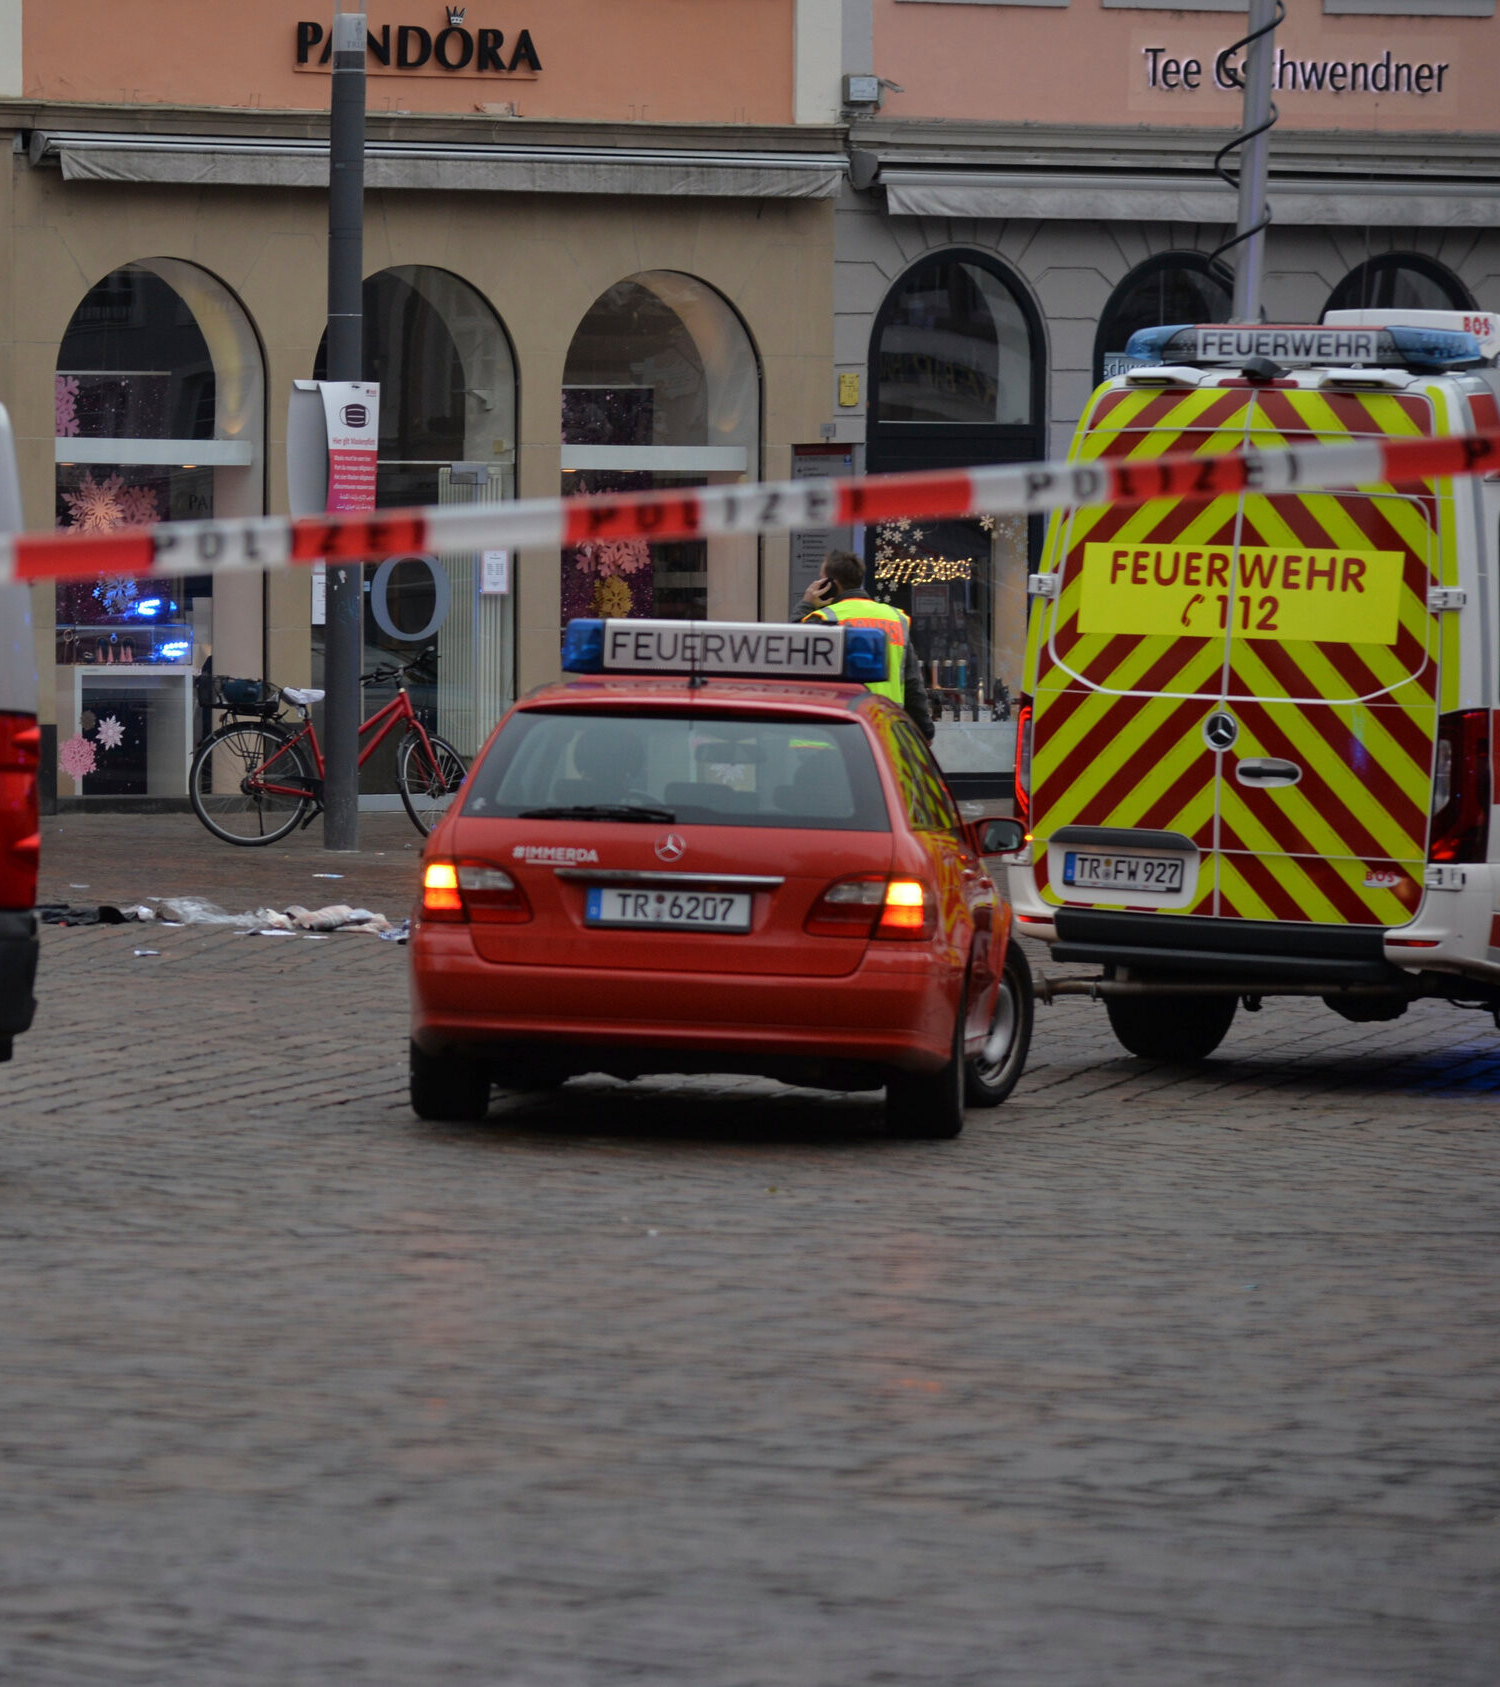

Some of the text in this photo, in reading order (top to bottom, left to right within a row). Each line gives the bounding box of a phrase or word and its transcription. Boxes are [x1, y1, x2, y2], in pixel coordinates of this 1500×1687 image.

[297, 21, 542, 71] PNDORA
[1143, 47, 1449, 93] Tee Ghwendner
[1463, 315, 1491, 337] BOS
[1202, 331, 1373, 359] FEUERWEHR
[151, 519, 424, 563] POLIZEI
[588, 487, 866, 535] POLIZEI
[1023, 451, 1297, 500] POLIZEI
[1110, 550, 1366, 593] FEUERWEHR
[1216, 594, 1280, 631] 112
[611, 631, 835, 667] FEUERWEHR
[512, 845, 599, 864] #IMMERDA
[1078, 857, 1180, 884] TR FW 927
[1365, 870, 1396, 883] BOS
[617, 892, 735, 921] TR 6207
